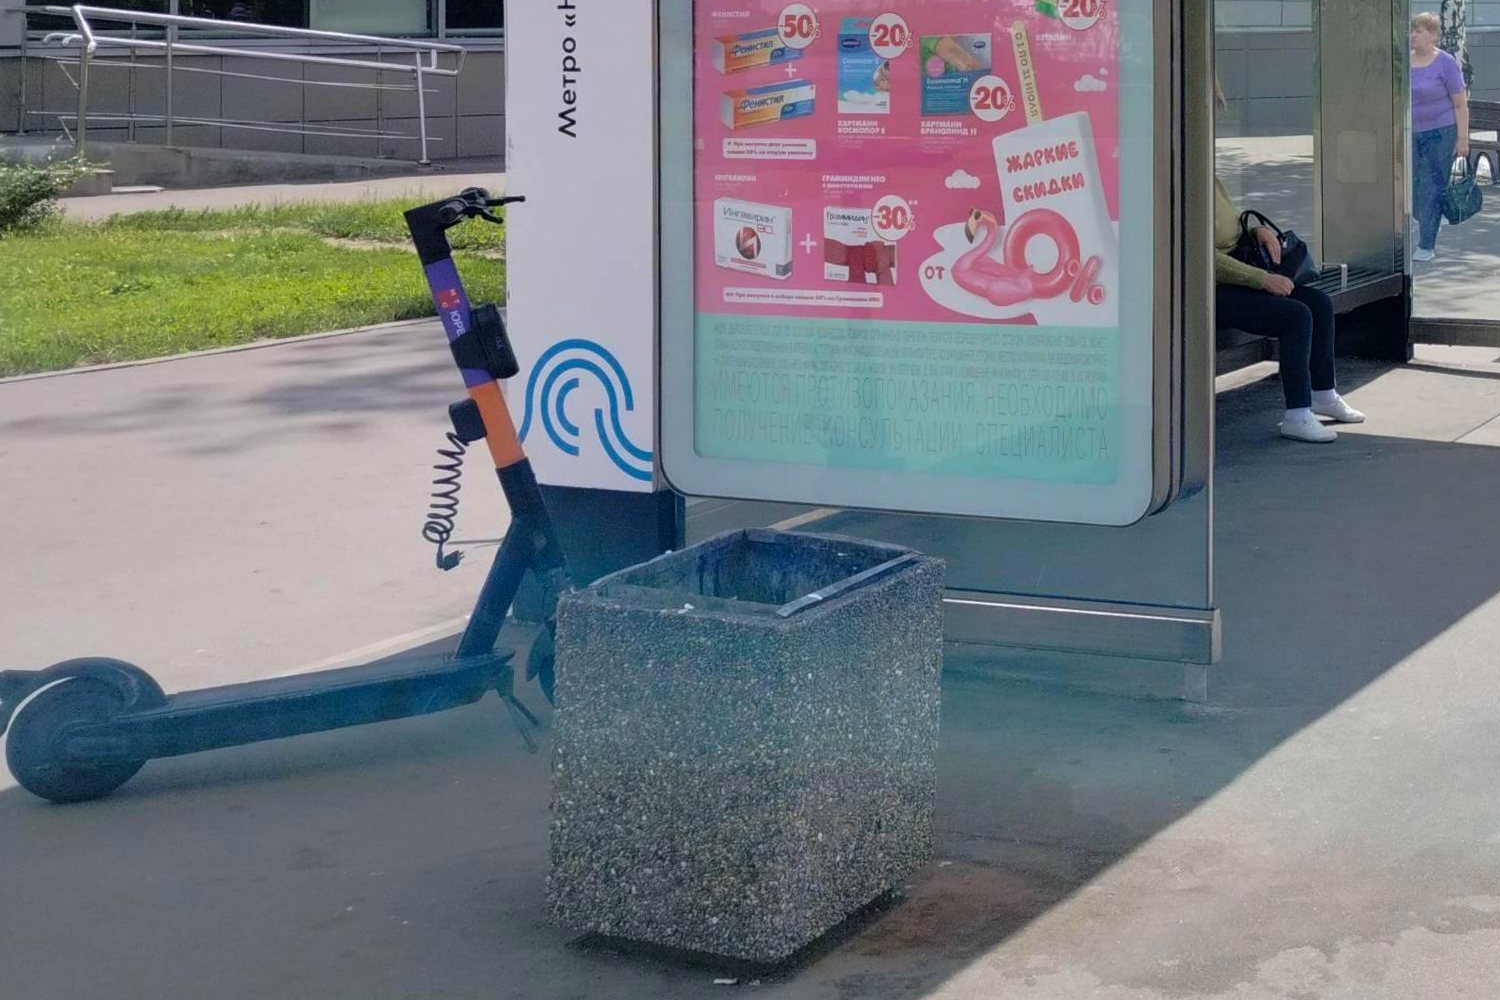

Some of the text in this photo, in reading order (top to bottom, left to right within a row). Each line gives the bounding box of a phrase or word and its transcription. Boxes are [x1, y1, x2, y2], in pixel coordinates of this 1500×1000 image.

[731, 40, 774, 57] Фенистил
[870, 23, 914, 49] -20%
[558, 36, 581, 139] Метро
[740, 95, 785, 110] Фенистил
[971, 85, 1016, 112] -20%
[1005, 140, 1080, 174] ЖАРКИЕ
[1012, 171, 1085, 204] СКИДКИ
[985, 386, 1109, 423] НЕОБХОДИМО
[713, 408, 1109, 463] ПОЛУЧЕНИЕ КОНСУЛЬТАЦИИ СПЕЦИАЛИСТА
